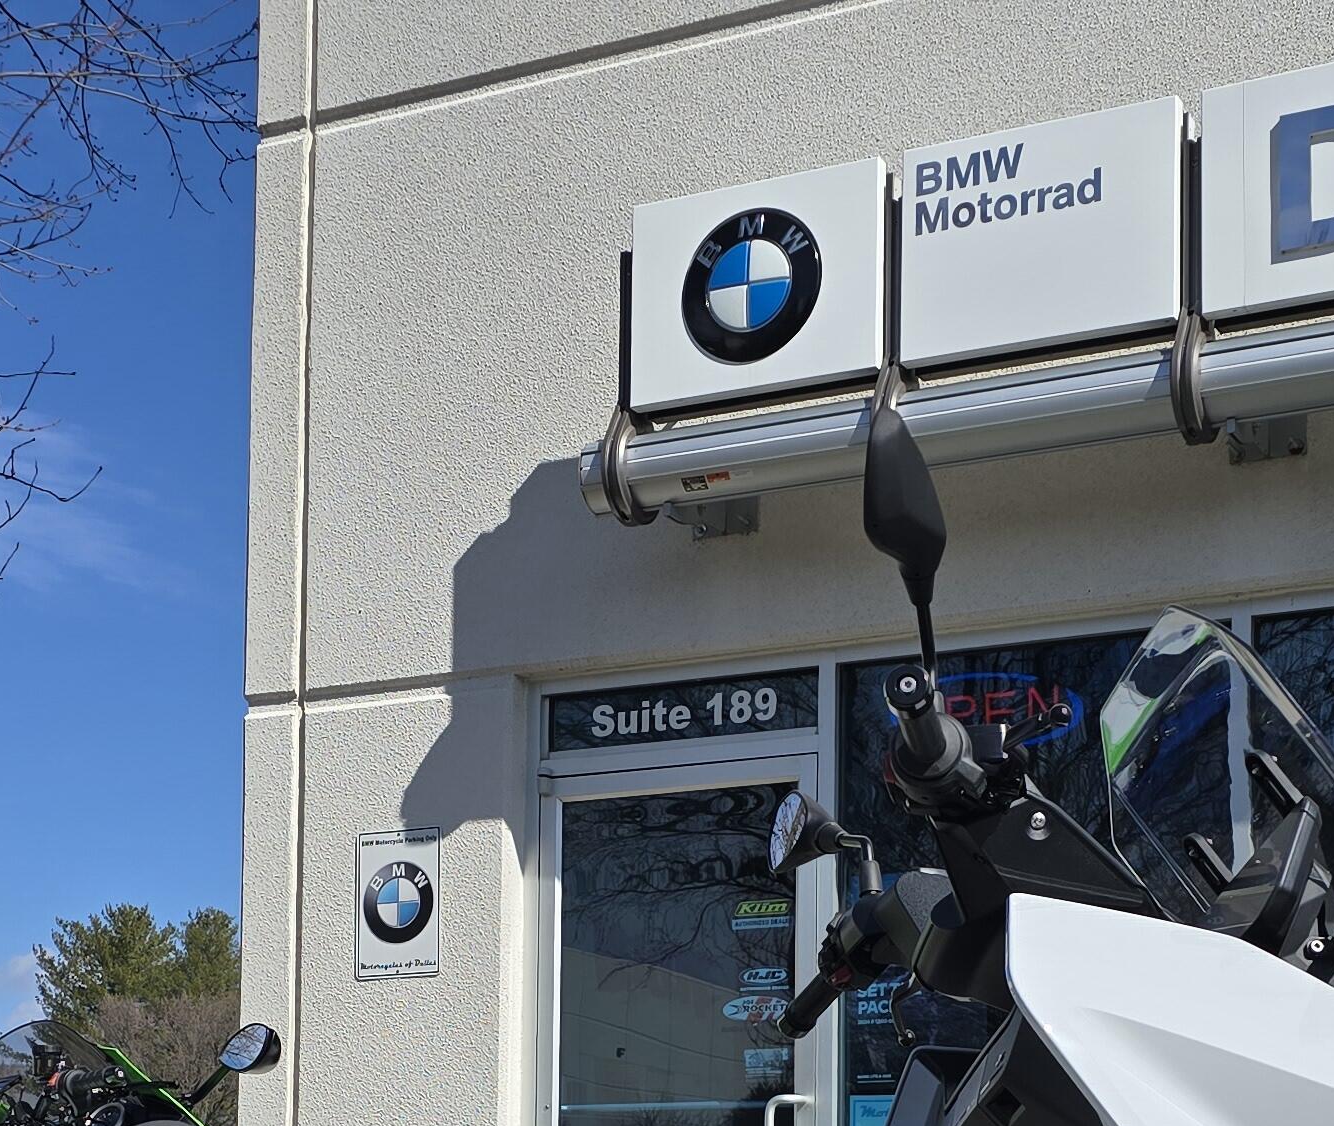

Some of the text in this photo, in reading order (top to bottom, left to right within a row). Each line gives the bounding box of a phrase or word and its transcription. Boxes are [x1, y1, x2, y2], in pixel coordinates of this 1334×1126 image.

[915, 142, 1025, 199] BMW
[914, 167, 1103, 236] Motorrad
[697, 214, 809, 269] BMW
[591, 687, 778, 738] Suite 189
[944, 684, 1060, 725] PEN
[370, 863, 429, 892] BMW
[858, 1000, 890, 1015] PAC
